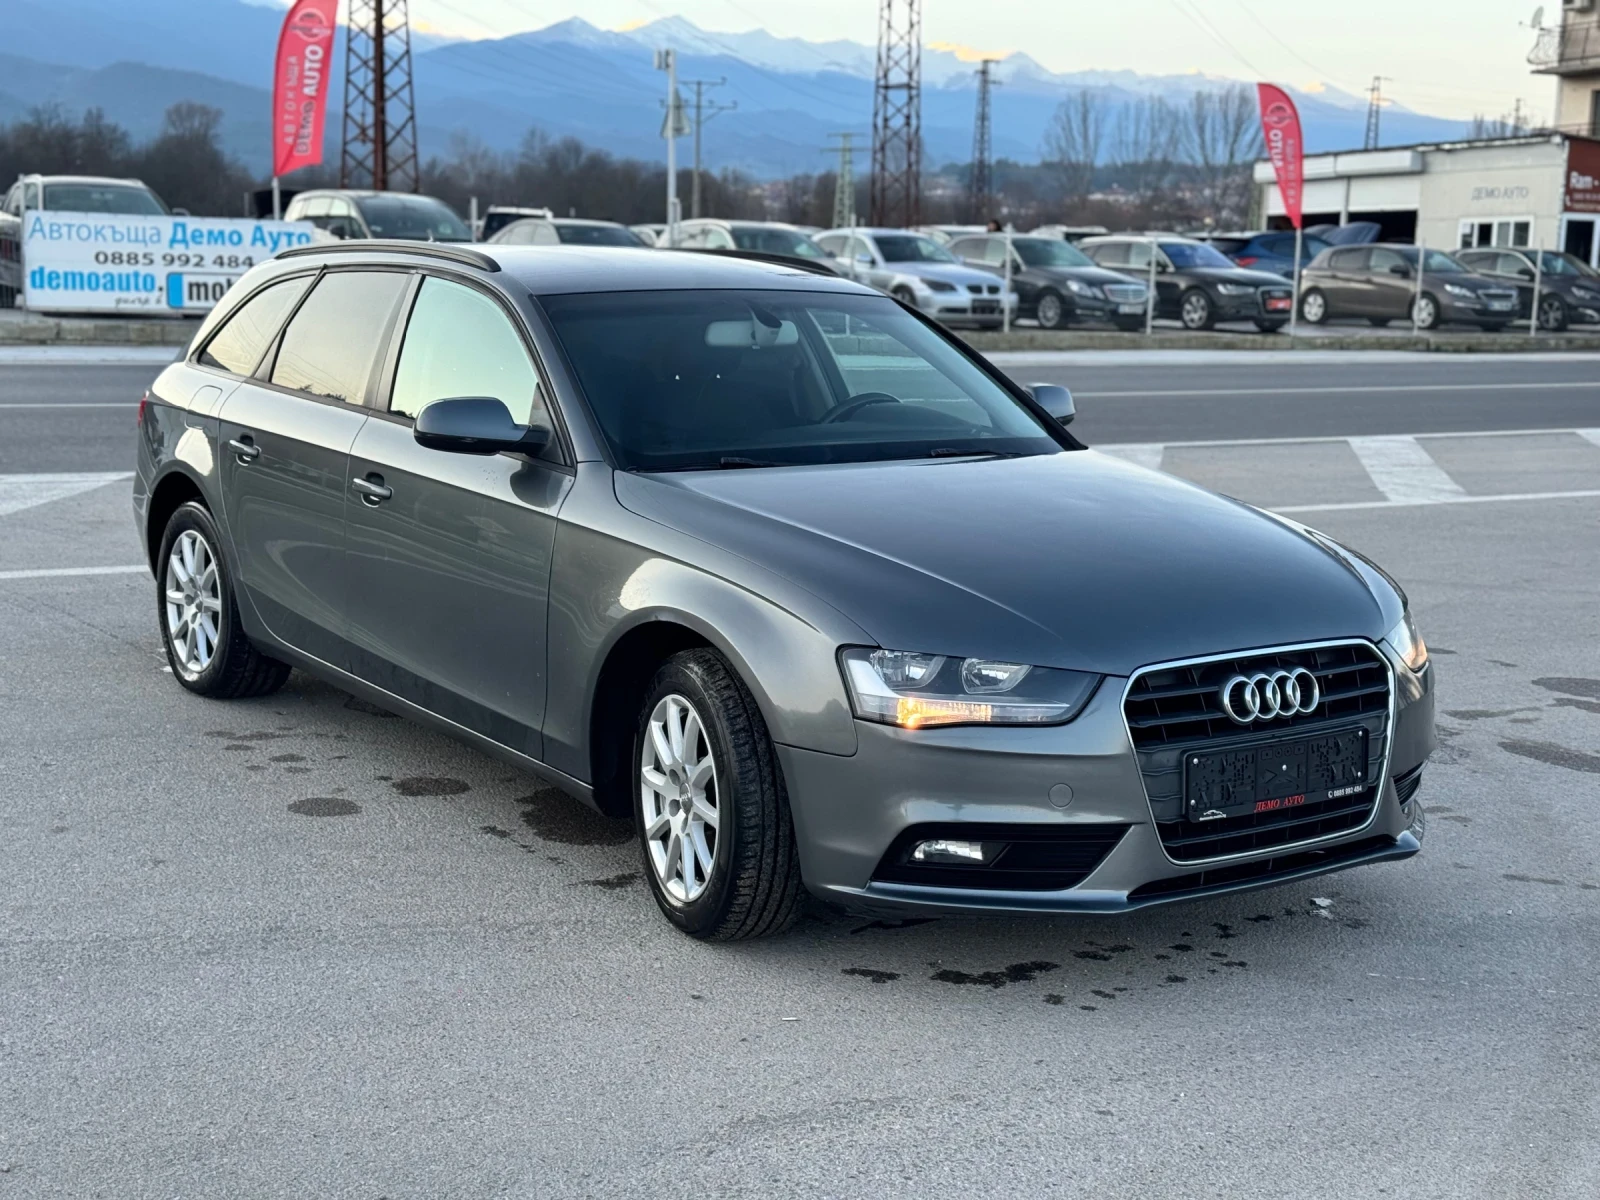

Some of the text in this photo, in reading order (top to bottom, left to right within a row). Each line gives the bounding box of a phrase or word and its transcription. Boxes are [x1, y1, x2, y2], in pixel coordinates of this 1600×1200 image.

[303, 44, 324, 96] AUTO
[28, 217, 311, 252] Автокъща Демо Ауто
[95, 251, 254, 269] 0885 992 484
[1254, 794, 1305, 812] ДЕМО АУТО
